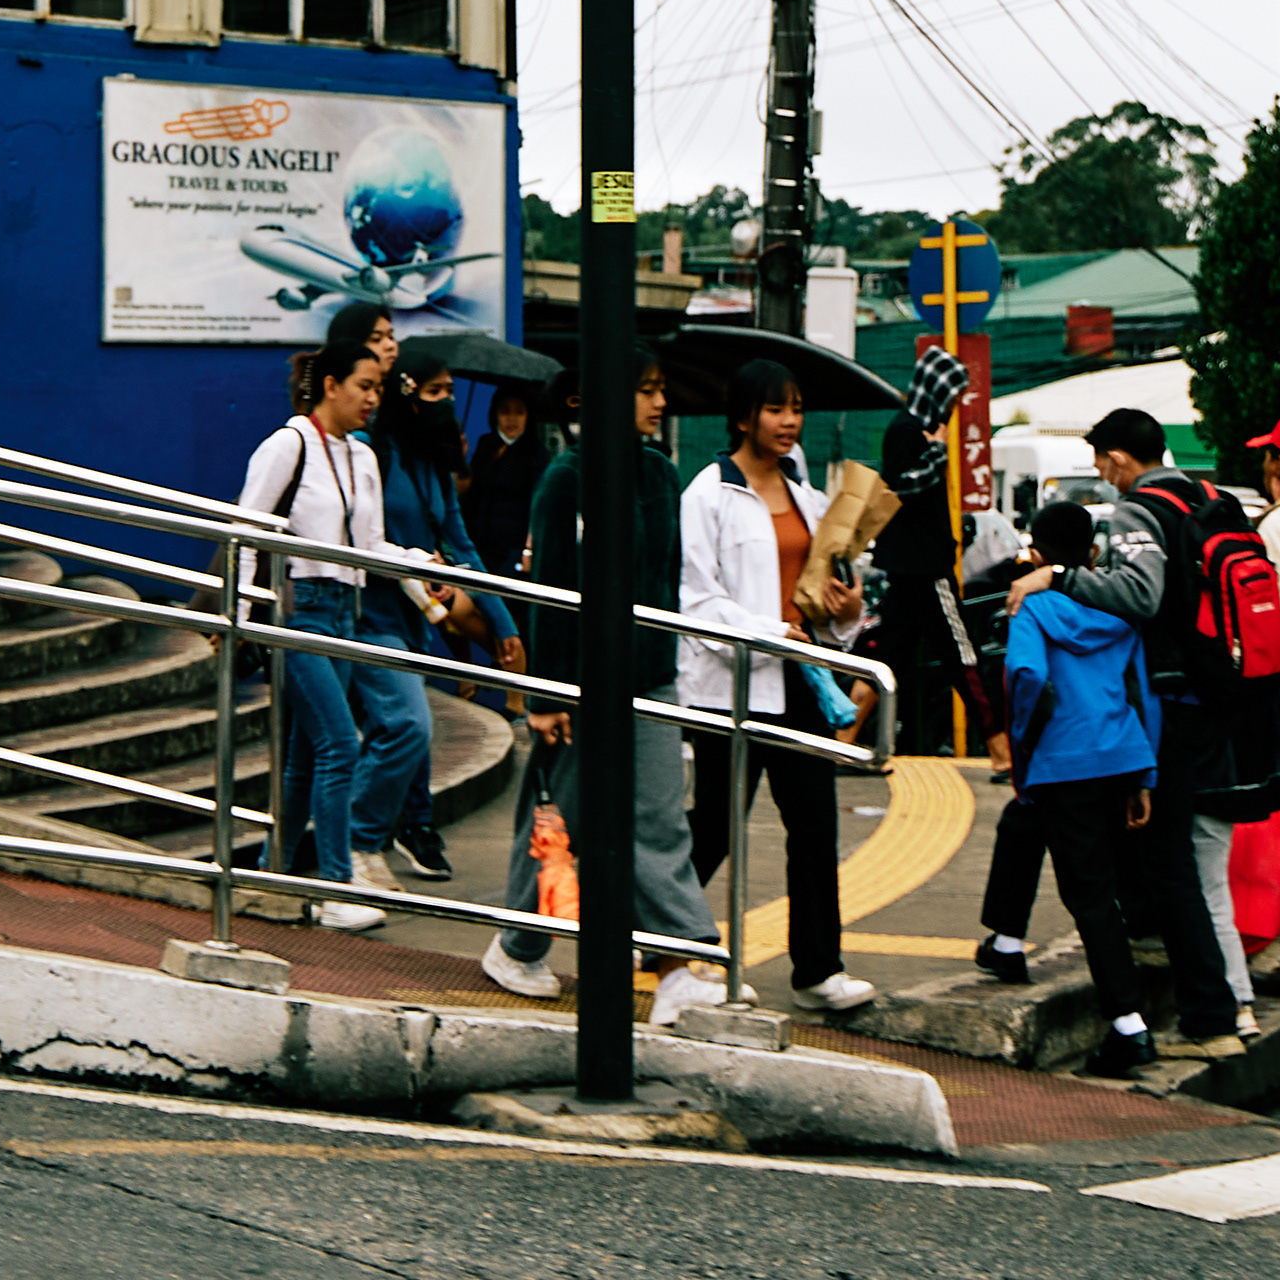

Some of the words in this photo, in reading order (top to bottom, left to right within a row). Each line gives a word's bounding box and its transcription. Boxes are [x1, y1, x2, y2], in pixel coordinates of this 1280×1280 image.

[112, 140, 240, 169] GRACIOUS
[169, 175, 219, 191] TRAVEL
[225, 179, 236, 191] &
[240, 178, 288, 194] TOURS
